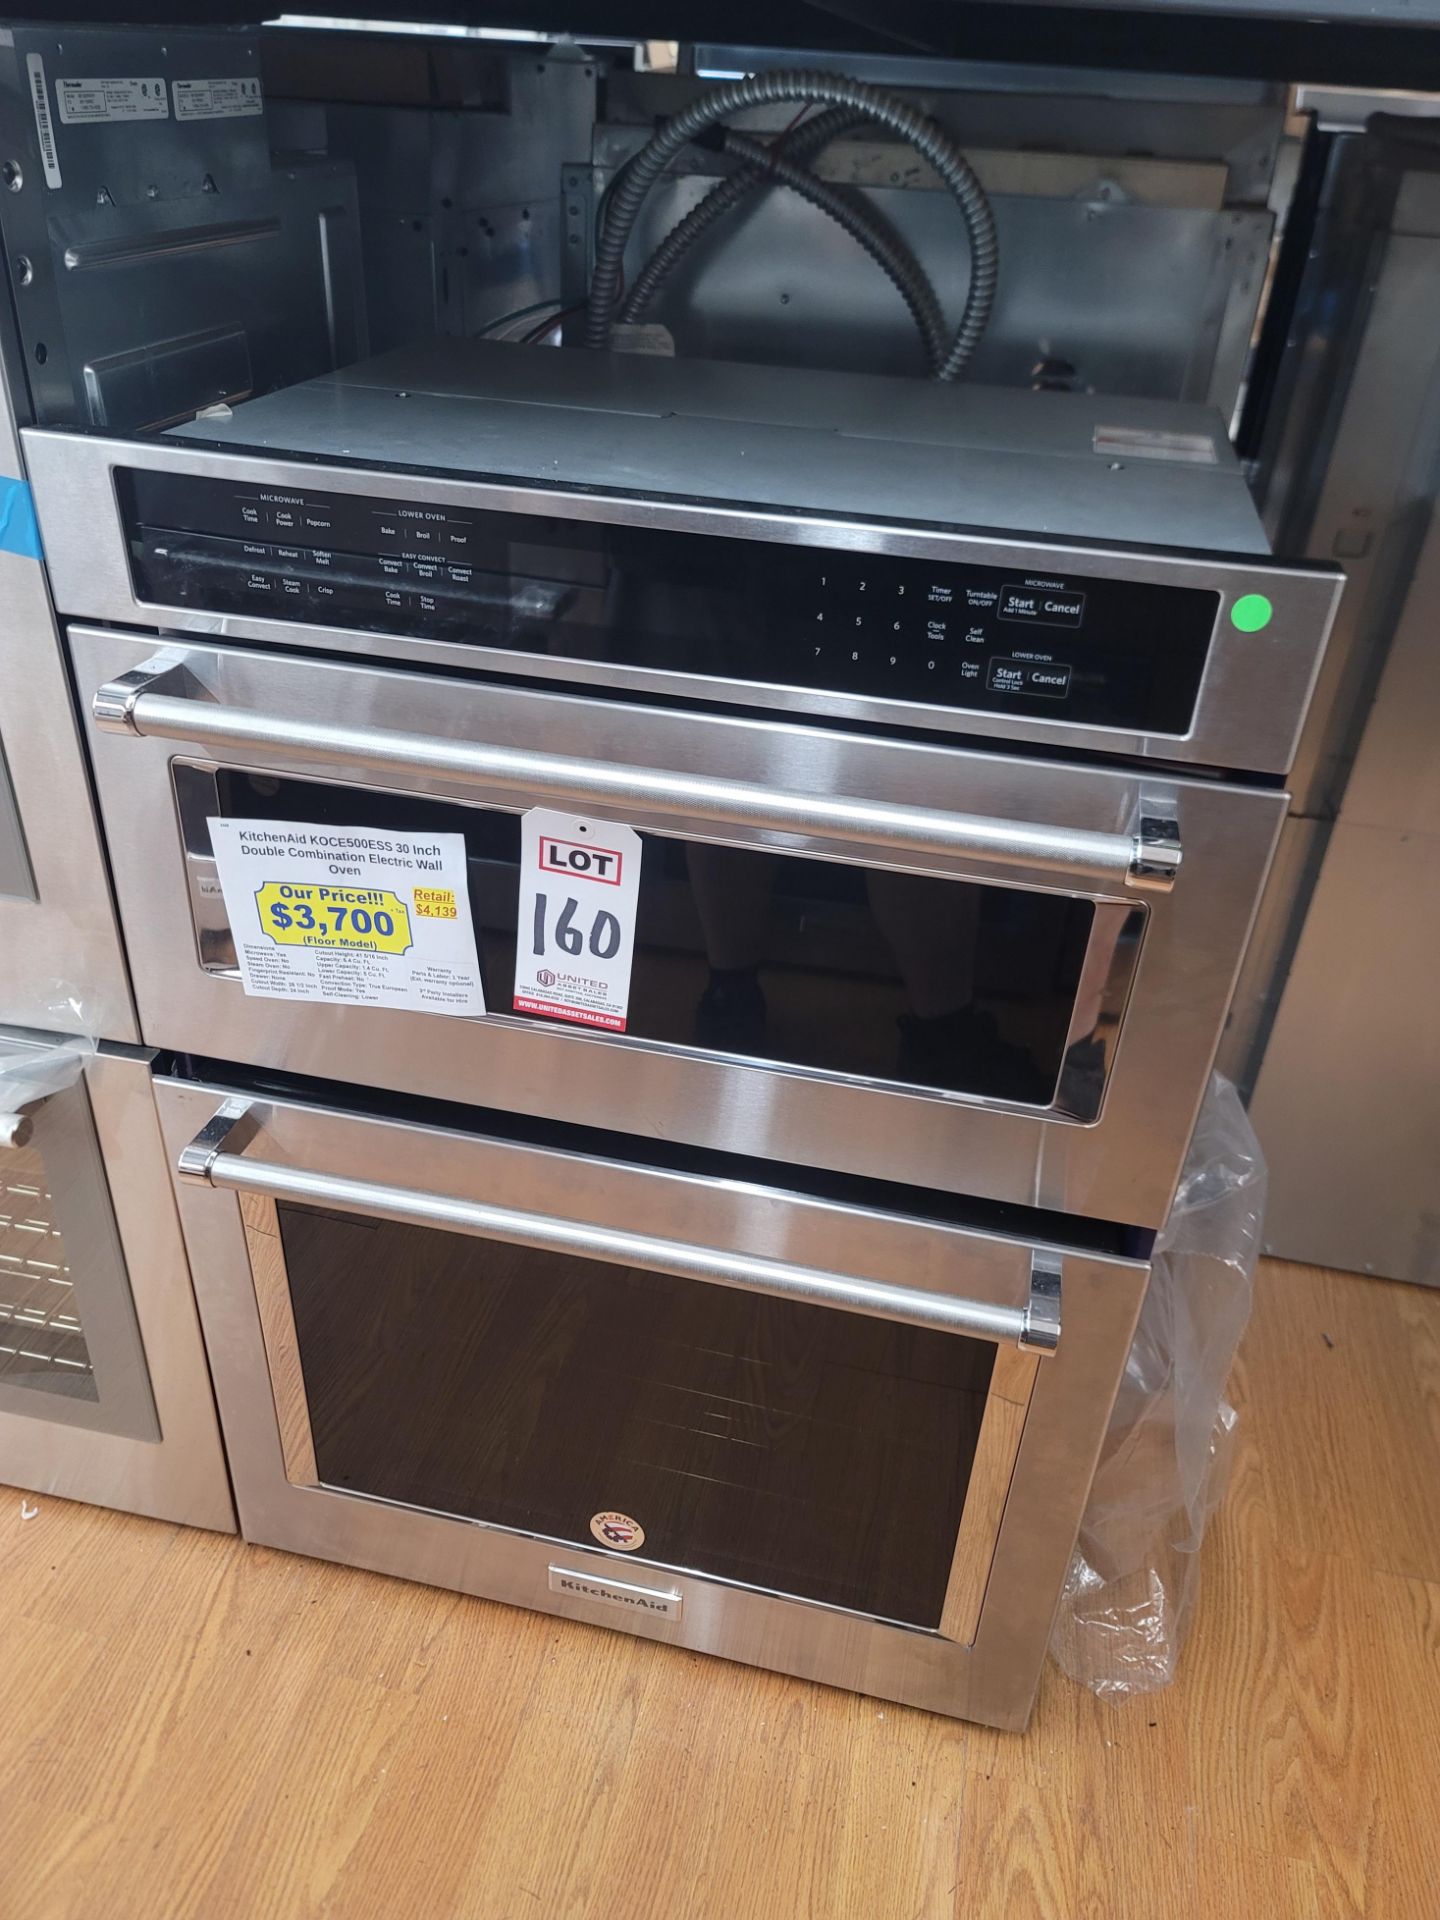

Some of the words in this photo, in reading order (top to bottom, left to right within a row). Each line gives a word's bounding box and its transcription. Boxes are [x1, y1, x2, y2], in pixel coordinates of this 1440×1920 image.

[260, 494, 304, 505] MICROWAVE
[242, 507, 257, 515] Cook
[398, 510, 423, 519] LOWER
[425, 513, 446, 521] OVEN
[276, 519, 294, 527] Power
[306, 518, 330, 527] Popcorn
[381, 527, 395, 535] Bake
[416, 531, 430, 539] Broil
[450, 535, 467, 543] Proof
[244, 545, 265, 554] Defrost
[278, 549, 298, 558] Reheat
[312, 550, 331, 558] Soften
[402, 552, 417, 560] EASY
[417, 555, 446, 563] CONVECT
[379, 558, 402, 567] Convect
[413, 562, 438, 571] Convect
[419, 570, 433, 578] Broil
[448, 566, 472, 575] Convect
[251, 574, 265, 583] Easy
[452, 574, 469, 582] Roast
[248, 581, 271, 590] Convect
[282, 579, 300, 587] Steam
[821, 577, 826, 586] 1
[859, 582, 866, 591] 2
[898, 586, 904, 595] 3
[1024, 579, 1064, 590] MICROWAVE
[318, 586, 333, 595] Crisp
[385, 591, 400, 599] Cook
[932, 586, 951, 595] Timer
[966, 590, 998, 600] Turntable
[386, 598, 401, 606] Time
[420, 596, 434, 604] Stop
[928, 594, 953, 602] SET/OFF
[420, 602, 435, 611] Time
[968, 599, 993, 607] ON/OFF
[1008, 597, 1035, 609] Start
[1044, 601, 1080, 615] Cancel
[1018, 608, 1038, 616] Minute
[816, 613, 823, 622] 4
[856, 617, 862, 626] 5
[893, 621, 900, 631] 6
[927, 621, 946, 630] Clock
[927, 631, 944, 640] Tools
[969, 628, 983, 636] Self
[965, 635, 985, 643] Clean
[815, 648, 821, 656] 7
[852, 652, 858, 661] 8
[890, 656, 896, 665] 9
[928, 661, 935, 669] 0
[1012, 651, 1034, 660] LOWER
[1034, 654, 1052, 662] OVEN
[961, 661, 980, 670] Oven
[961, 669, 978, 678] Light
[997, 668, 1022, 680] Start
[1032, 673, 1067, 686] Cancel
[239, 831, 306, 845] KitchenAid
[310, 836, 392, 851] KOCE500ESS
[396, 843, 410, 854] 30
[413, 844, 441, 856] Inch
[241, 845, 285, 857] Double
[288, 848, 365, 863] Combination
[369, 854, 413, 868] Electric
[416, 860, 443, 871] Wall
[549, 845, 613, 875] LOT
[329, 864, 361, 876] Oven
[280, 886, 313, 899] Our
[319, 889, 384, 906] Price!!!
[414, 889, 455, 903] Retail:
[416, 904, 457, 918] $4,139
[270, 902, 394, 937] $3,700
[533, 892, 621, 959] 160
[303, 936, 336, 947] (Floor
[339, 938, 377, 951] Model)
[557, 973, 608, 989] UNITED
[518, 1000, 621, 1026] WWW.UNITEDASSETSALES.COM
[595, 1513, 639, 1533] AMERICA
[561, 1579, 668, 1612] KitchenAid
